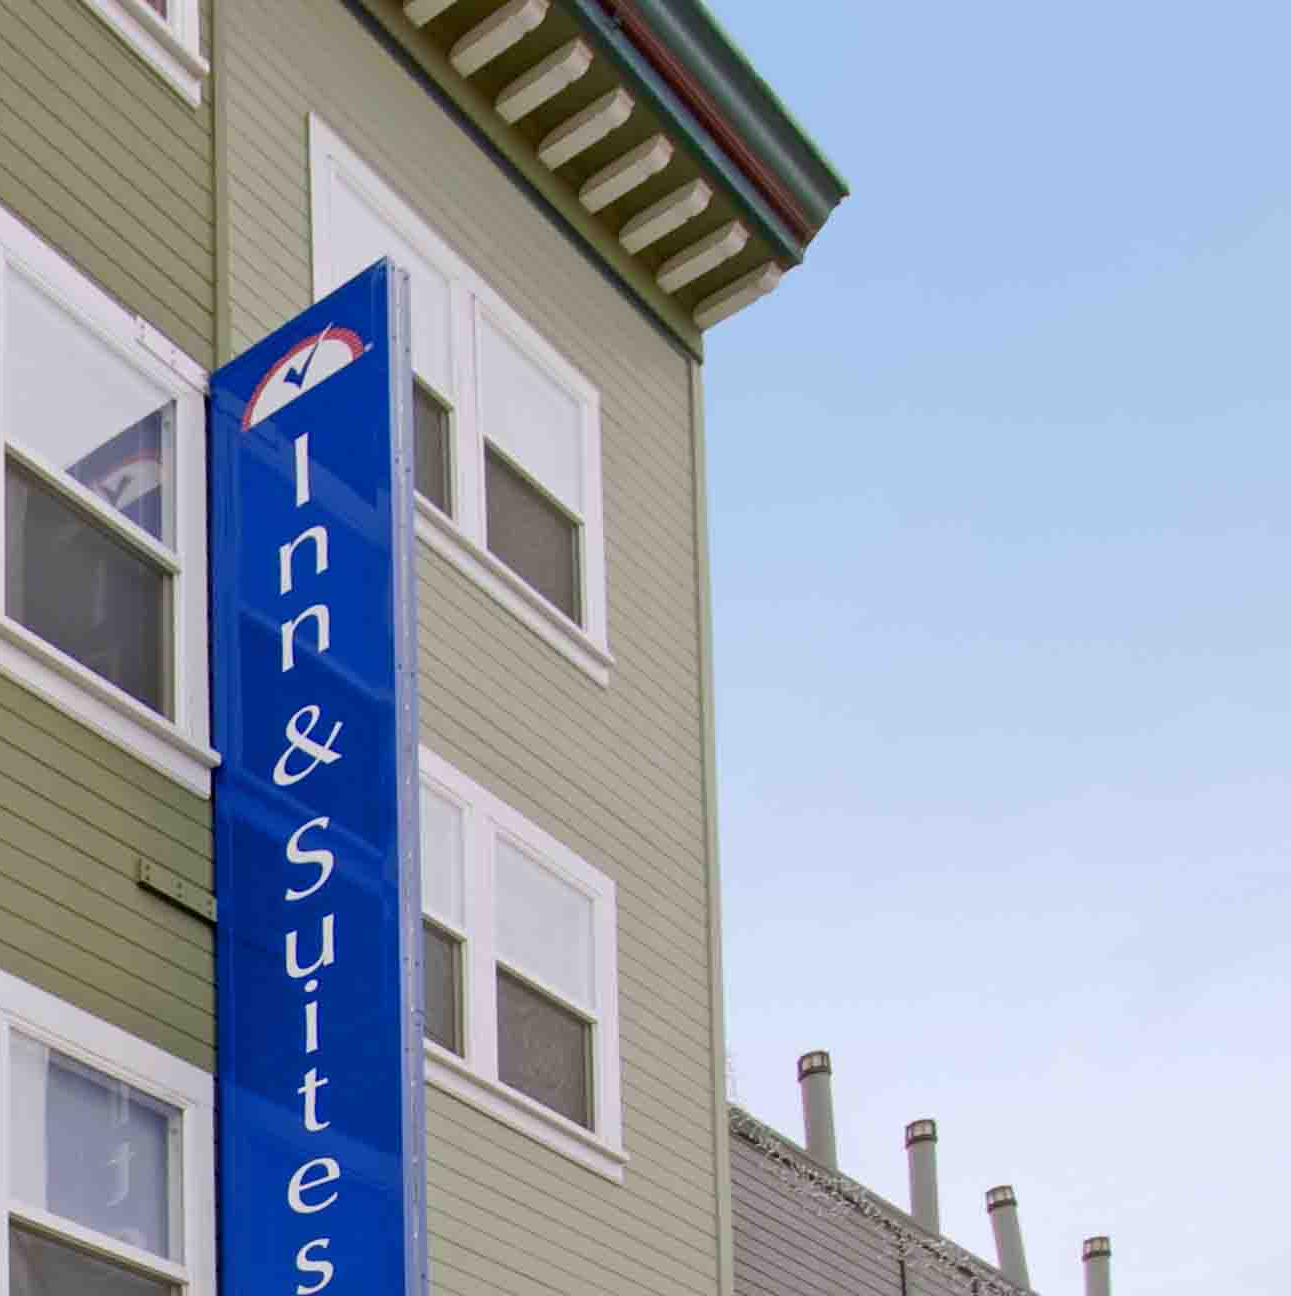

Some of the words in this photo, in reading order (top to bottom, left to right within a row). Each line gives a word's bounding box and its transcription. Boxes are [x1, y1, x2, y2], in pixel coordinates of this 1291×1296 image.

[277, 431, 330, 673] Inn
[273, 704, 343, 786] &
[283, 815, 341, 1296] Suites
